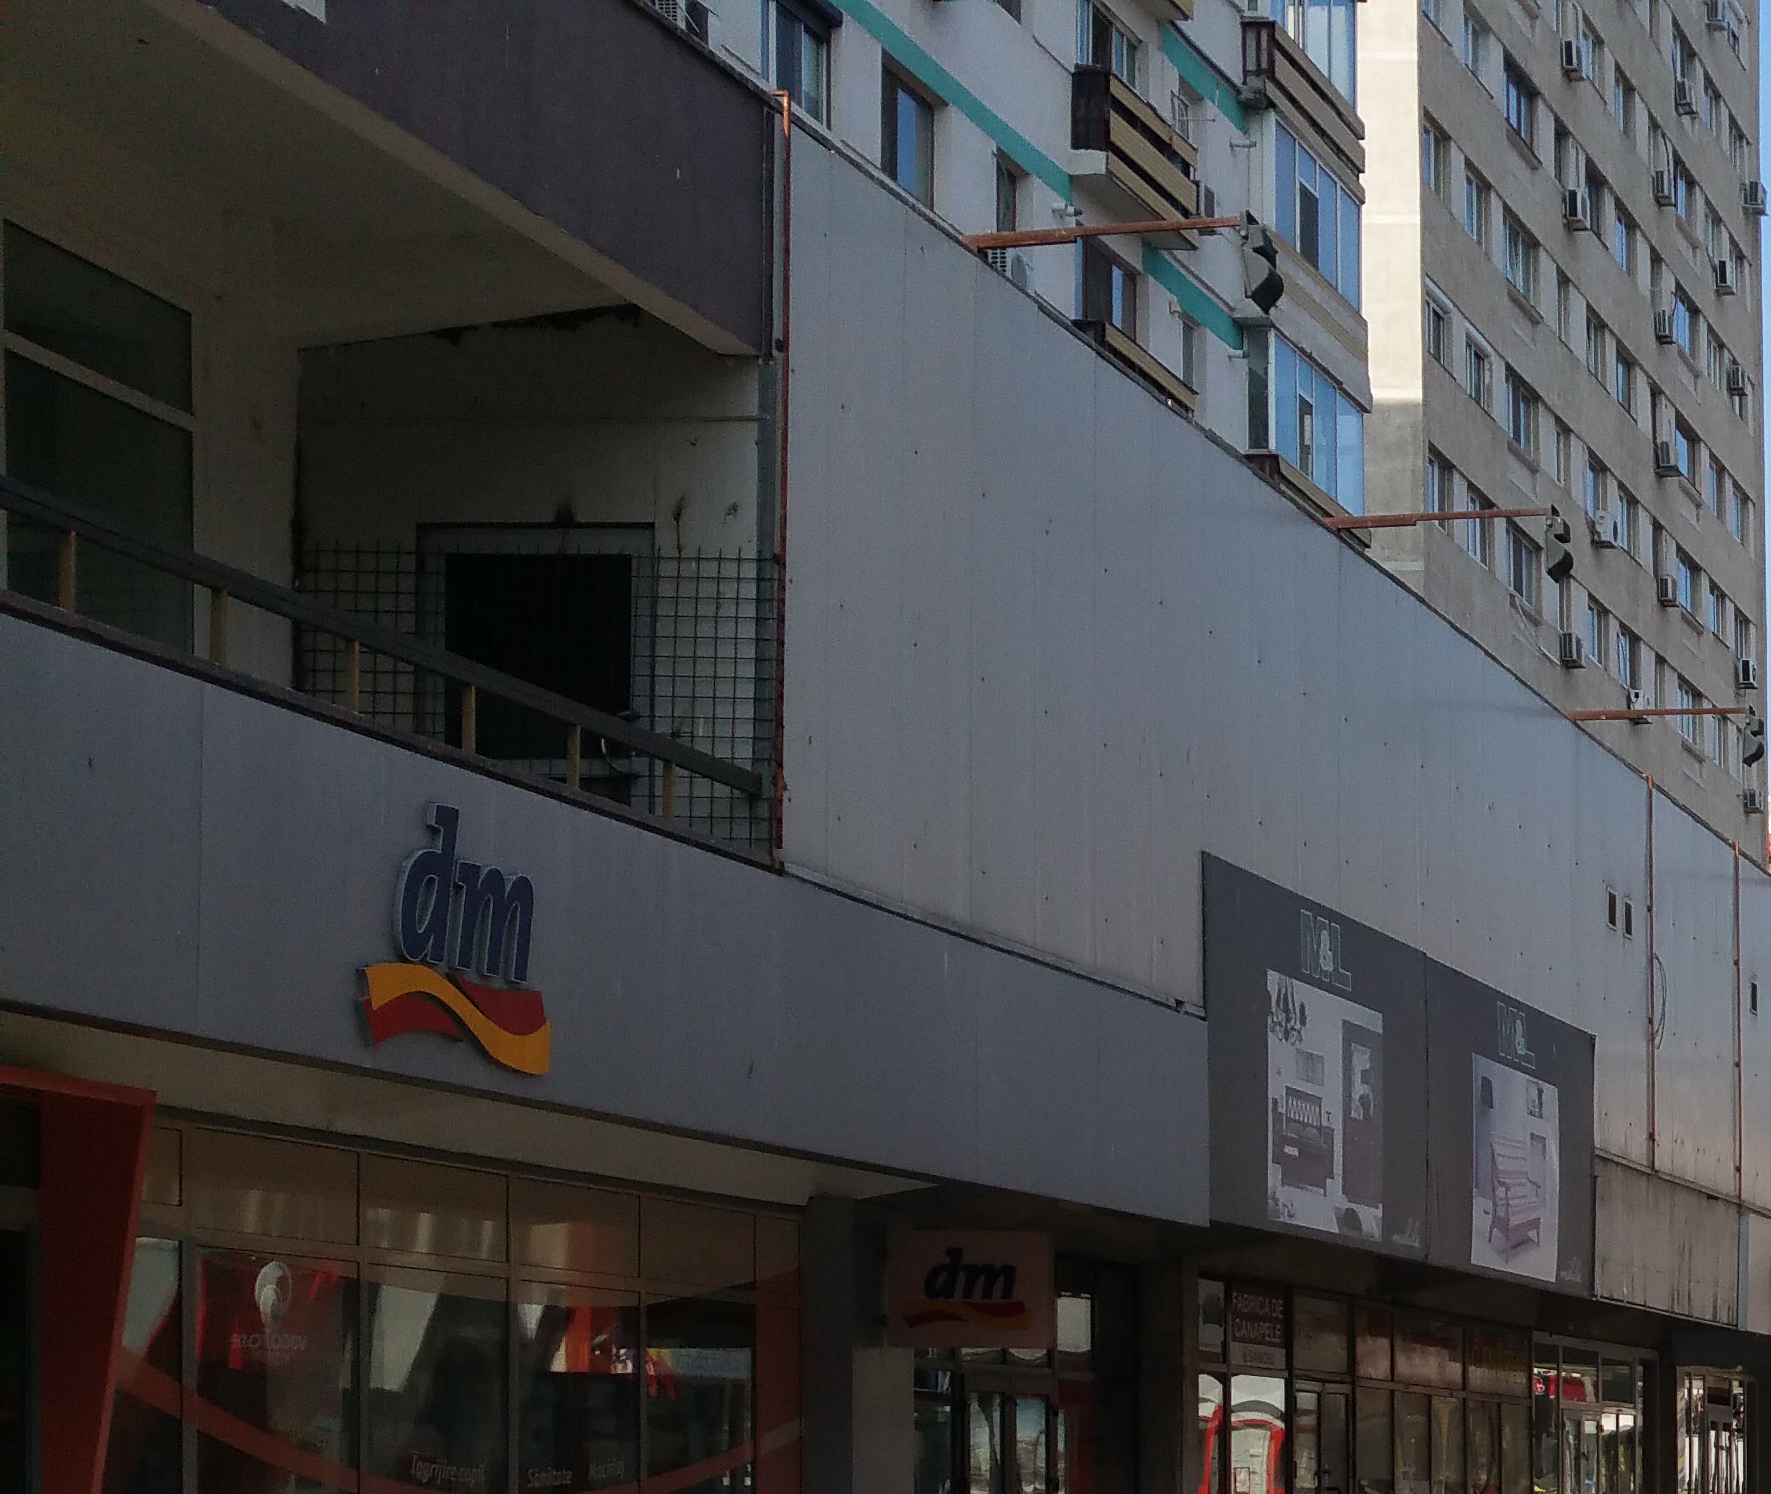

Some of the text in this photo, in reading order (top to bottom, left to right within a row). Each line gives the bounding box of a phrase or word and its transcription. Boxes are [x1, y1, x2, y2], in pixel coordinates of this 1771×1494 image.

[400, 802, 535, 984] dm
[924, 1247, 1017, 1301] dm
[1232, 1291, 1271, 1316] FABRICA
[1234, 1318, 1282, 1343] CANAPELE
